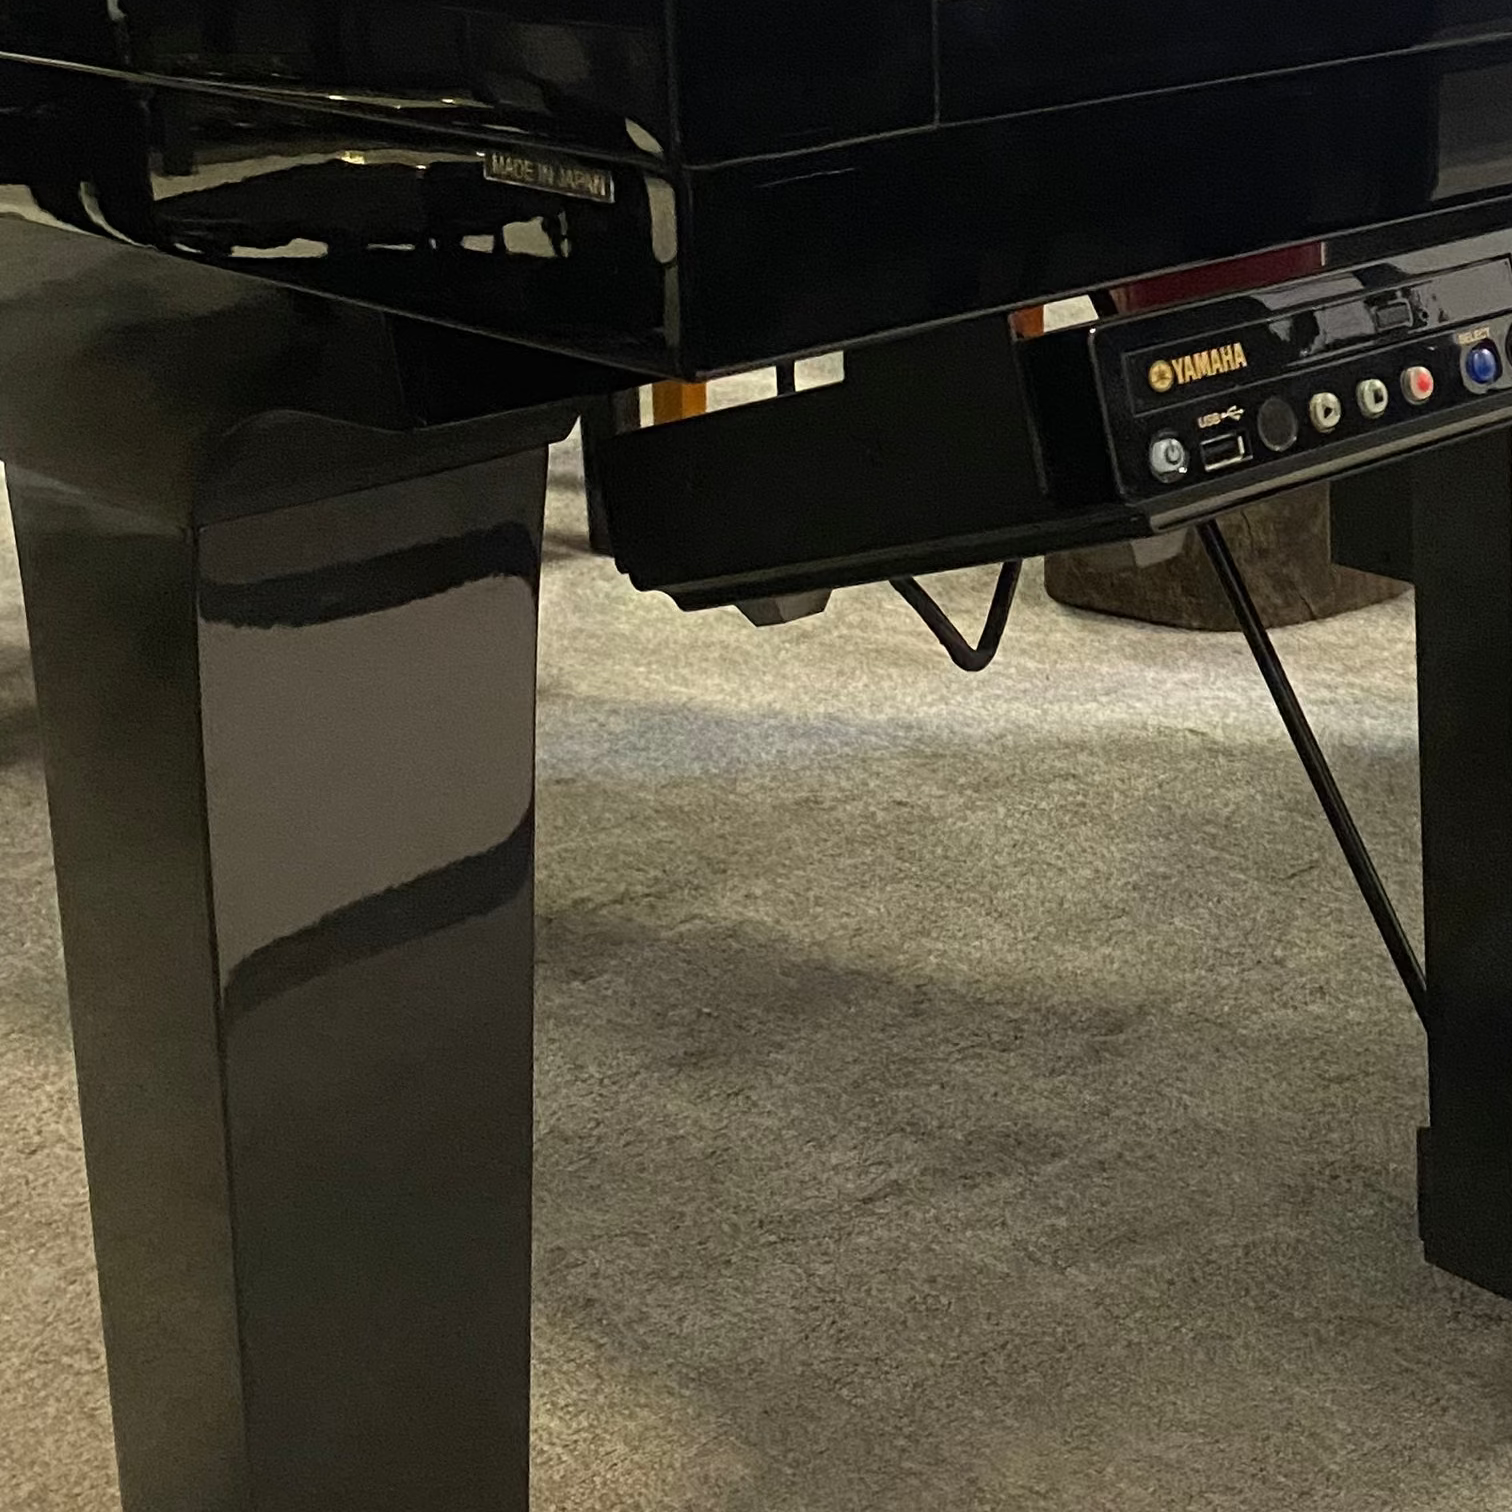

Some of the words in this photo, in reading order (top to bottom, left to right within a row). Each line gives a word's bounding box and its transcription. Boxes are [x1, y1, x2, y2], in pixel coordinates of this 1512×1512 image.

[492, 153, 535, 182] MADE
[538, 163, 554, 186] IN
[559, 167, 606, 196] JAPAN
[1456, 326, 1490, 345] SELECT
[1171, 342, 1248, 385] YAMAHA
[1198, 412, 1221, 428] USB
